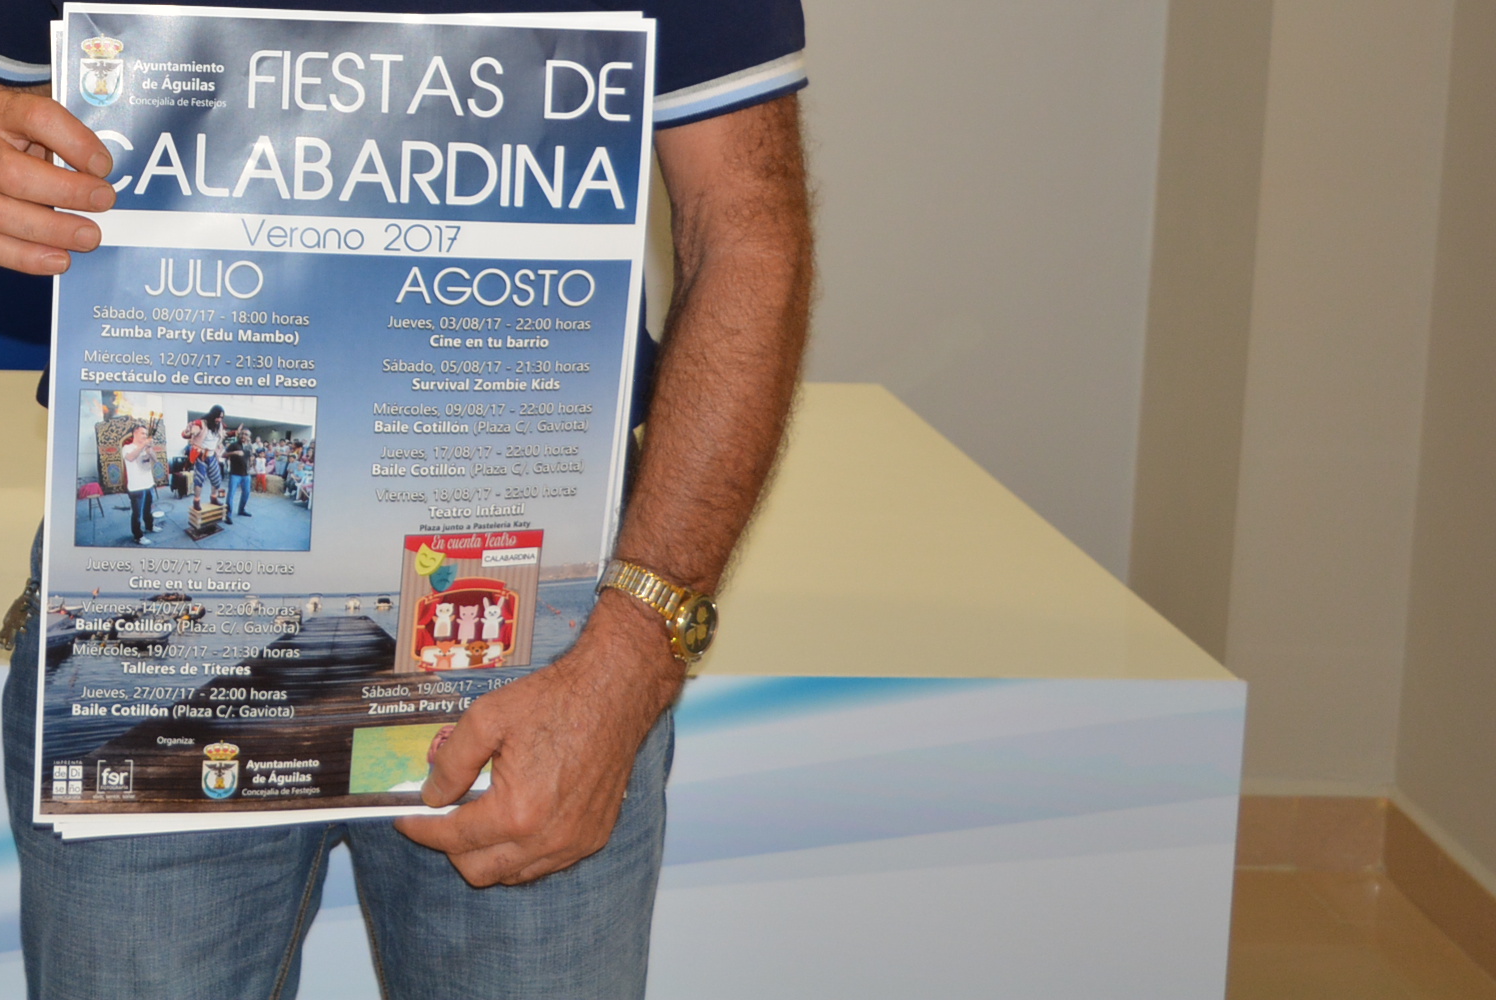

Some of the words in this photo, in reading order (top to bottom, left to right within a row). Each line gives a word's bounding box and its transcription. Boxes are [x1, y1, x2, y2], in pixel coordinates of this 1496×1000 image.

[133, 60, 224, 76] Ayuntamiento
[142, 78, 157, 89] de
[161, 76, 215, 93] Águilas
[247, 48, 507, 117] FIESTAS
[542, 60, 635, 121] DE
[240, 220, 365, 250] Verano
[383, 223, 460, 253] 2017
[145, 258, 263, 298] JULIO
[396, 267, 595, 306] AGOSTO
[101, 323, 151, 338] Zumba
[157, 326, 195, 342] Party
[200, 327, 232, 342] (Edu
[238, 329, 299, 344] Mambo)
[429, 334, 461, 347] Cine
[487, 336, 502, 347] tu
[506, 335, 548, 347] barrio
[411, 377, 469, 390] Survival
[473, 378, 526, 390] Zombie
[531, 377, 559, 389] Kids
[129, 576, 160, 589] Cine
[208, 578, 251, 590] barrio
[121, 661, 175, 674] Talleres
[180, 662, 197, 674] de
[202, 662, 251, 676] Títeres
[71, 703, 107, 716] Baile
[110, 703, 168, 717] Cotillón
[172, 704, 212, 719] (Plaza
[216, 704, 234, 719] C/.
[239, 704, 294, 718] Gaviota)
[245, 758, 319, 770] Ayuntamiento
[252, 773, 265, 784] de
[267, 772, 312, 785] Águilas
